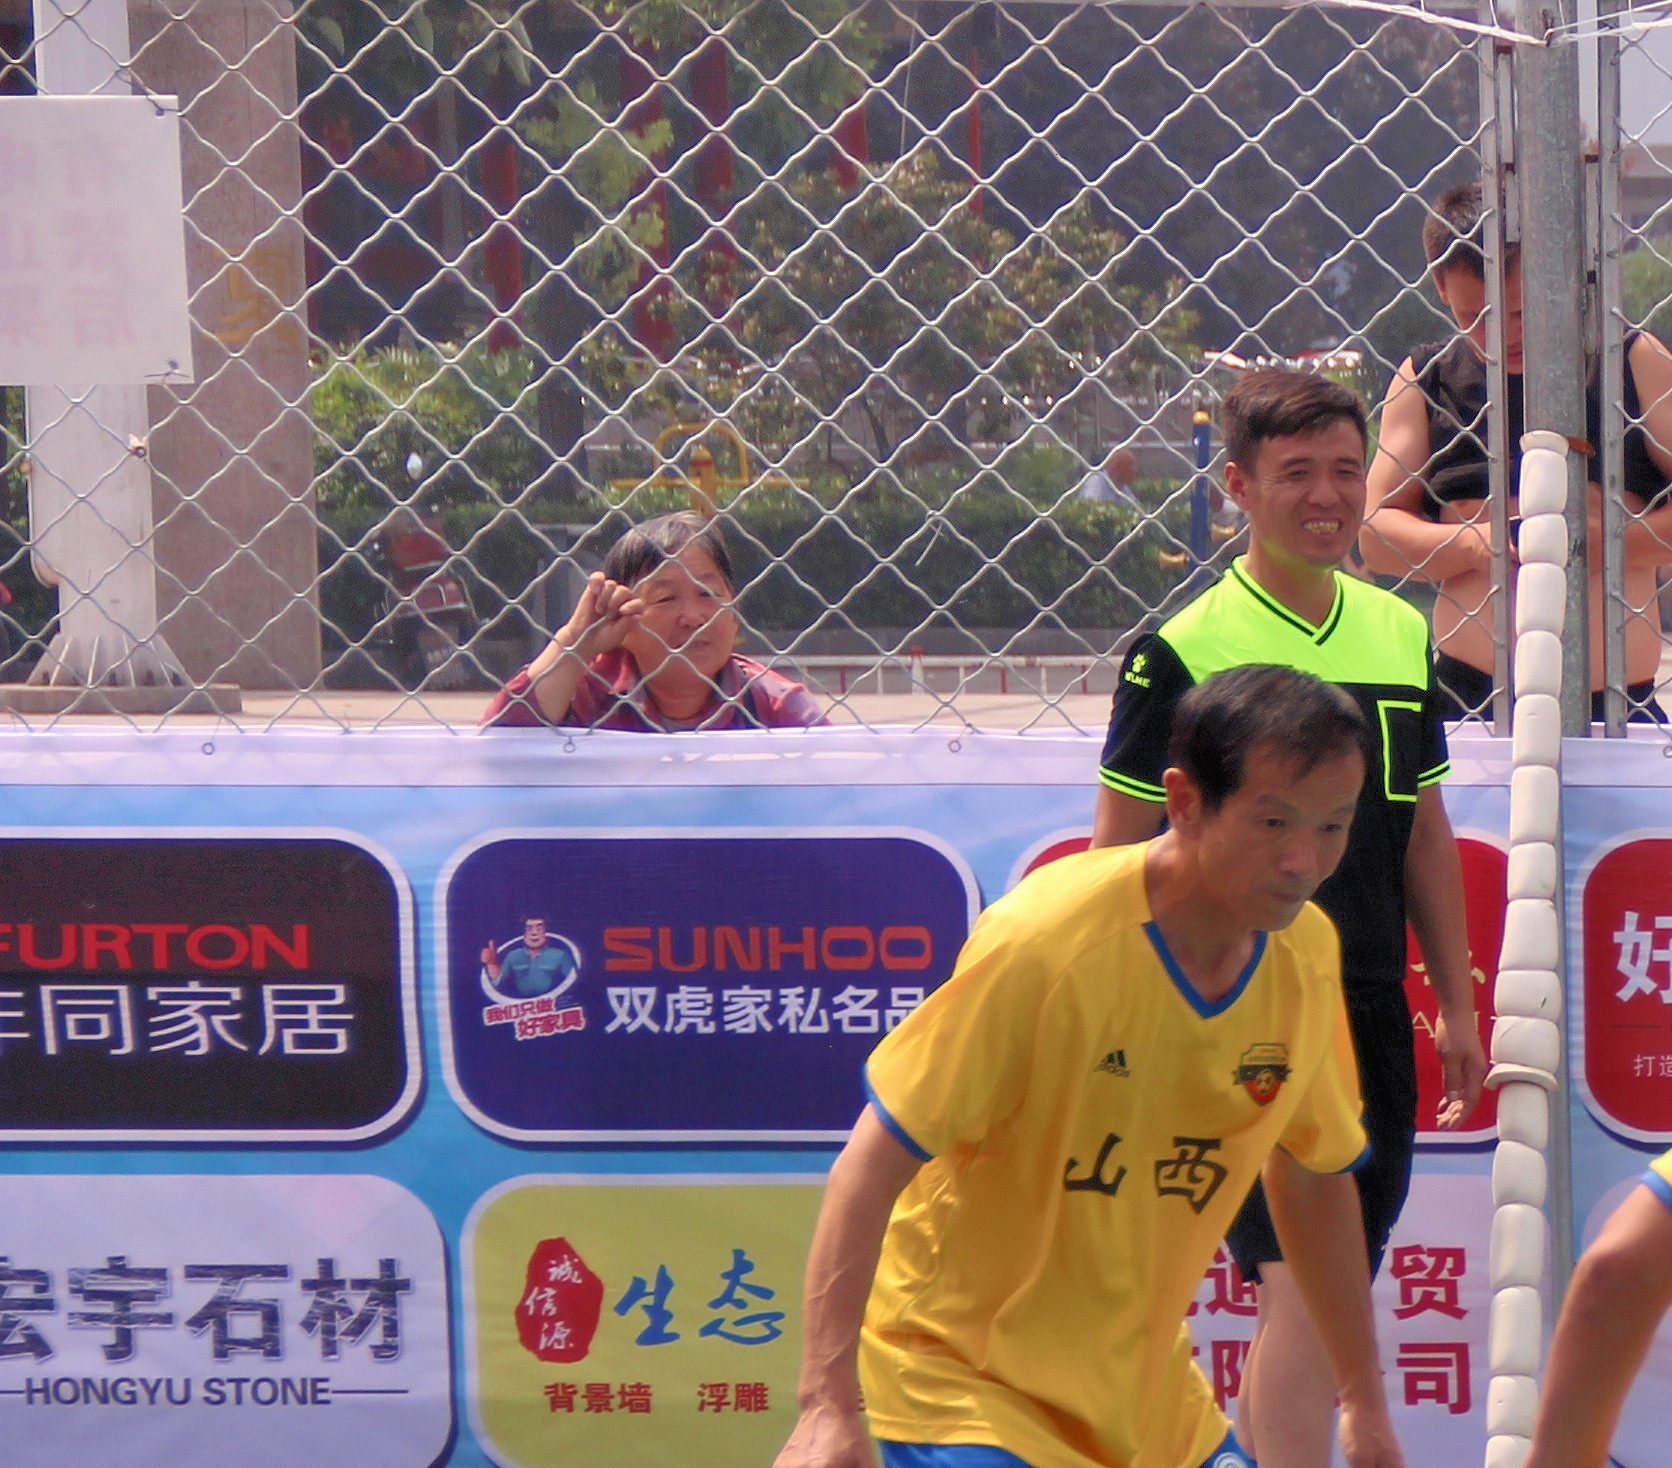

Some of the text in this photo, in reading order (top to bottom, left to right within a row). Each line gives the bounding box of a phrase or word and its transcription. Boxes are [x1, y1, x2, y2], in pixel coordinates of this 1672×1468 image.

[603, 925, 934, 973] SUNHOO
[0, 980, 354, 1056] 同家居
[604, 985, 926, 1034] 双虎家私名品
[1063, 1132, 1229, 1215] 山西
[613, 1248, 786, 1346] 生态
[26, 1377, 332, 1406] HONGYU STONE
[544, 1382, 770, 1414] 背景墙 浮雕
